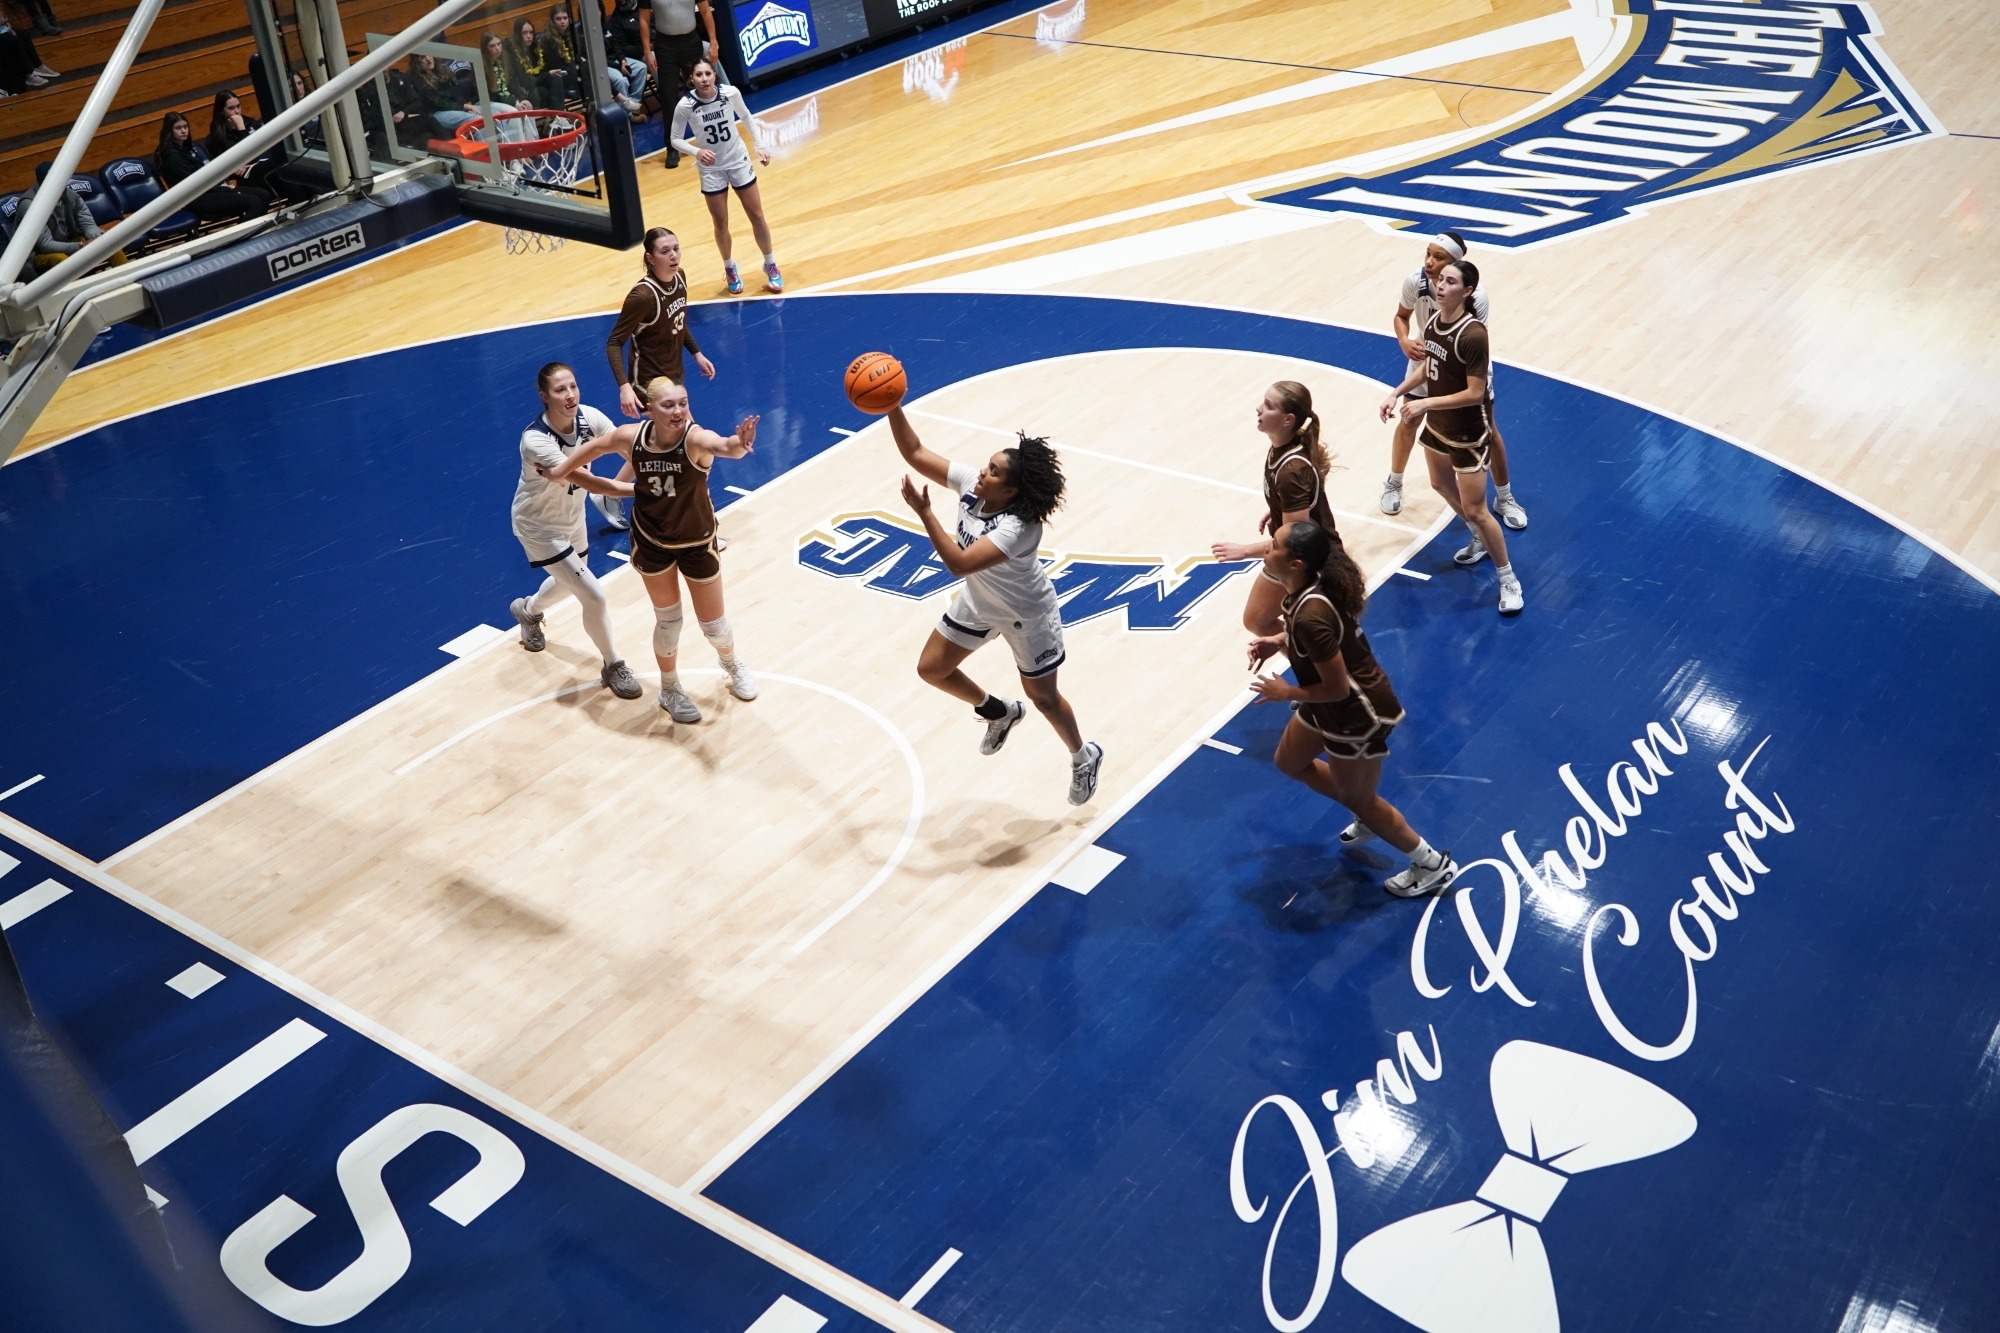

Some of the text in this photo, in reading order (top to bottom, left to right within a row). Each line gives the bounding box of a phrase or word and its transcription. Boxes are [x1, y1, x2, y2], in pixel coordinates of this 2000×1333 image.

[899, 6, 915, 18] THE
[742, 15, 807, 59] THE MOUNT
[702, 109, 725, 122] MOUNT
[1308, 0, 1847, 238] THE MOUNT
[704, 120, 731, 145] 35
[1425, 355, 1439, 382] 15
[639, 460, 682, 474] LEHIGH
[647, 475, 677, 498] 34
[799, 512, 1263, 632] MAC
[1583, 734, 1796, 1062] Court
[1230, 717, 1690, 1333] Jim Phelan
